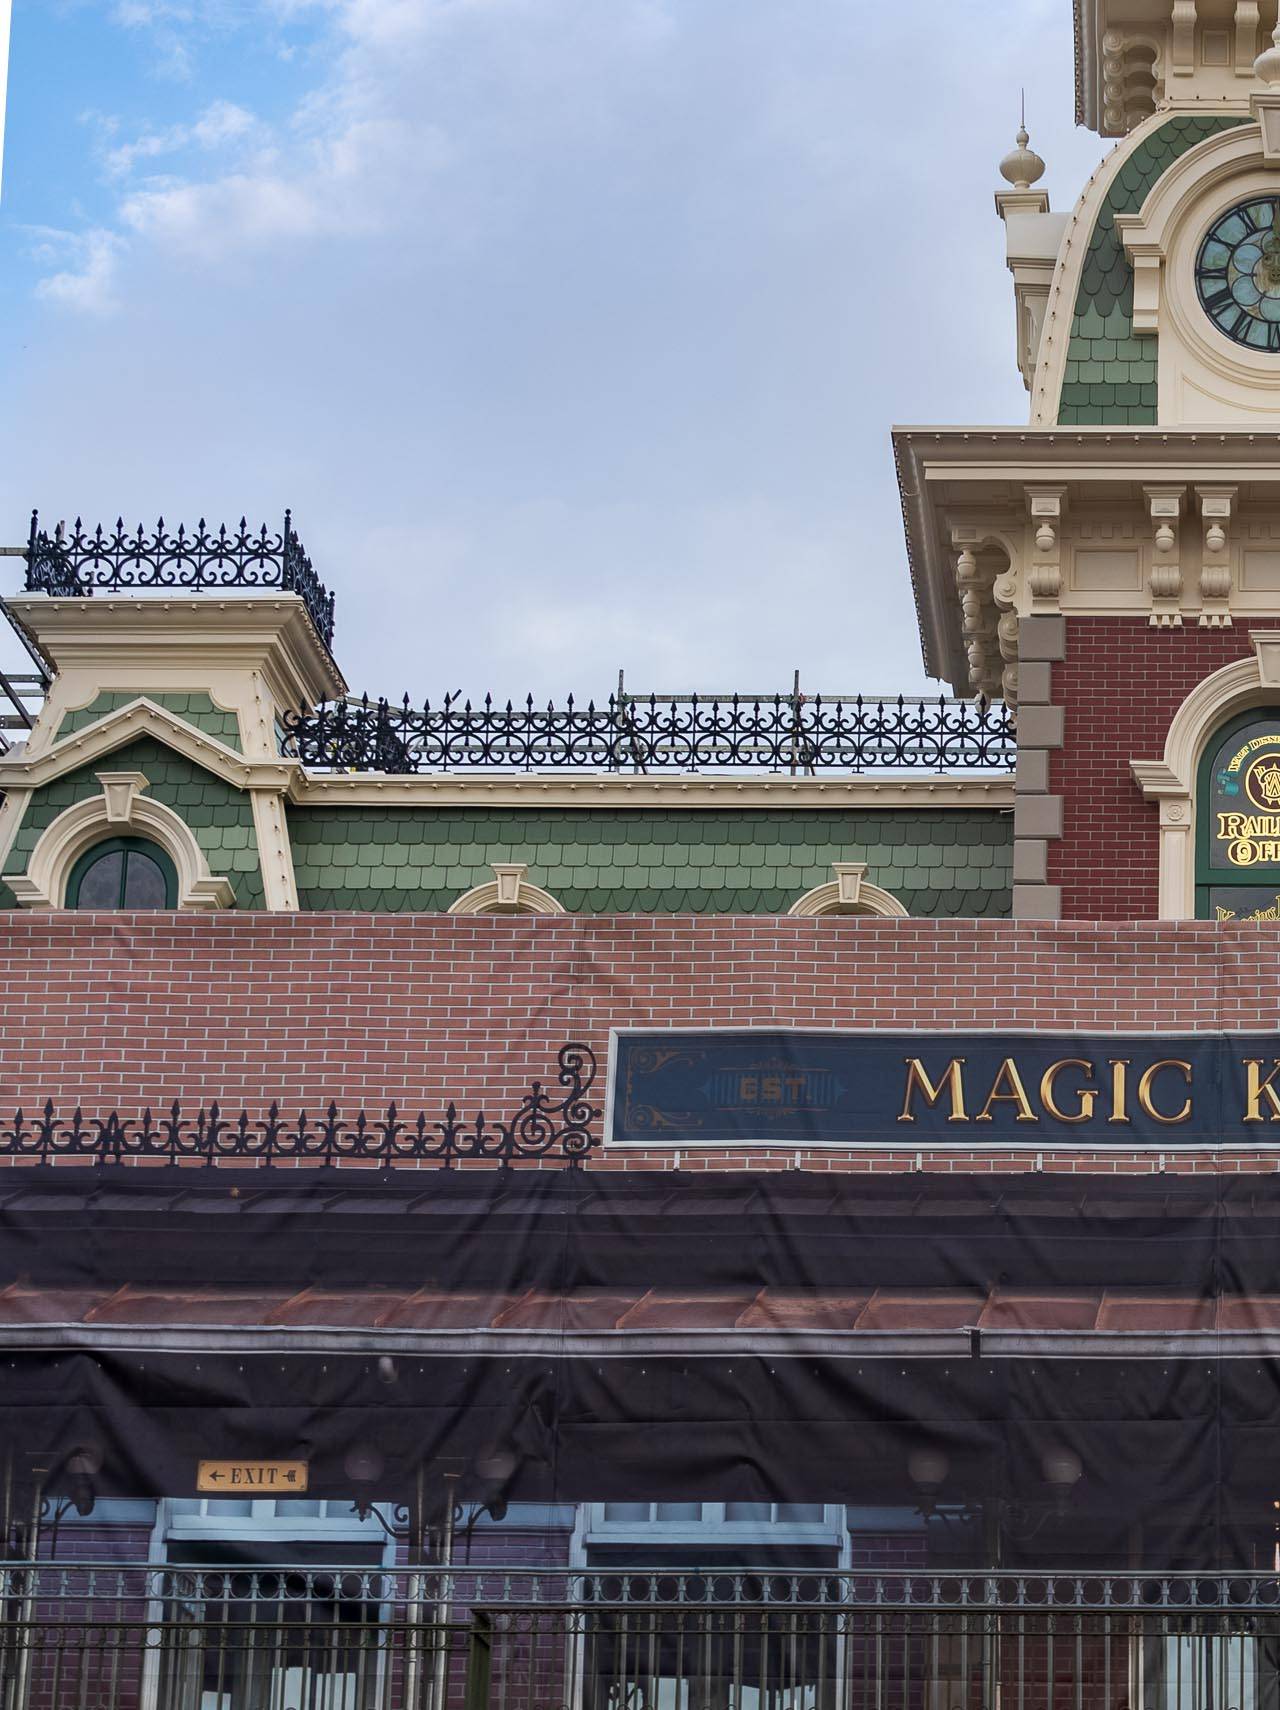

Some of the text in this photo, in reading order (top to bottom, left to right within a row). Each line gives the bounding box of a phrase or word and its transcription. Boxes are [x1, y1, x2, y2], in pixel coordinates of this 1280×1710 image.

[1228, 745, 1250, 772] WALT
[896, 1056, 1195, 1126] MAGIC
[231, 1467, 278, 1484] EXIT
